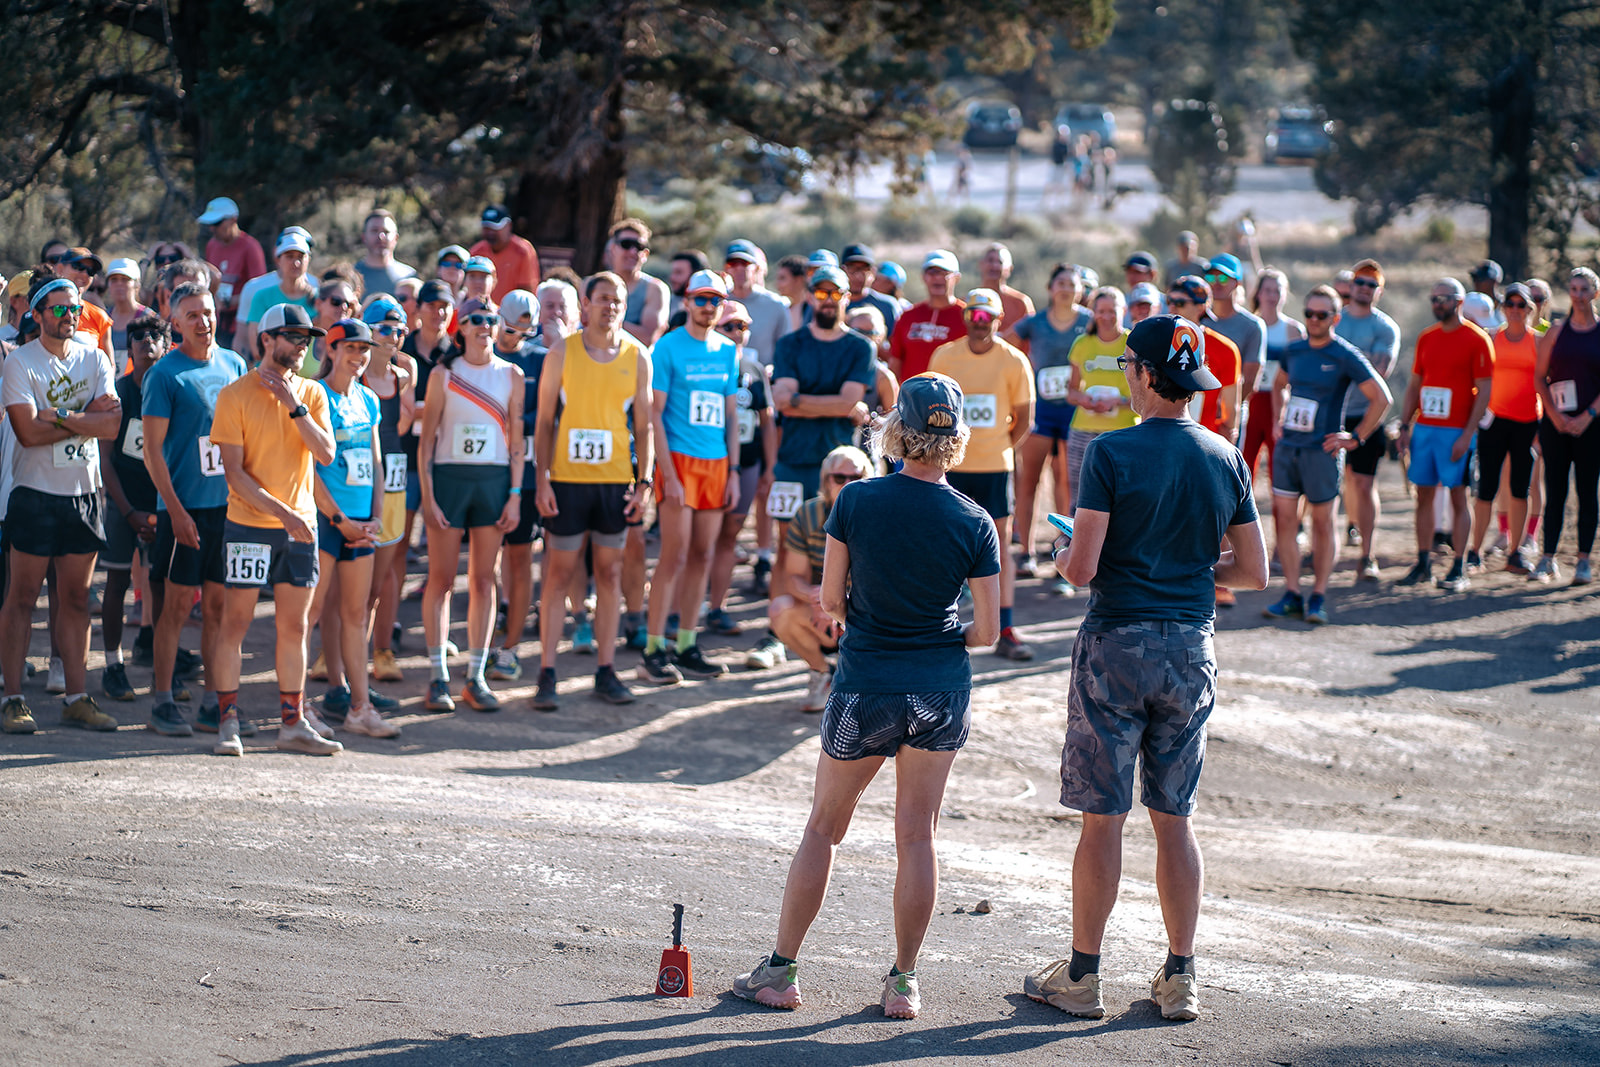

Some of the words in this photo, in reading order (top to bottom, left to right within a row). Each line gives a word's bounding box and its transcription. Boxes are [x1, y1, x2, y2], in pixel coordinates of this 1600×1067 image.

[46, 375, 88, 402] Eugene
[695, 404, 720, 425] 171
[464, 439, 487, 454] 87
[574, 441, 605, 460] 131
[770, 495, 797, 512] 137
[242, 545, 264, 553] Bend
[231, 558, 266, 580] 156
